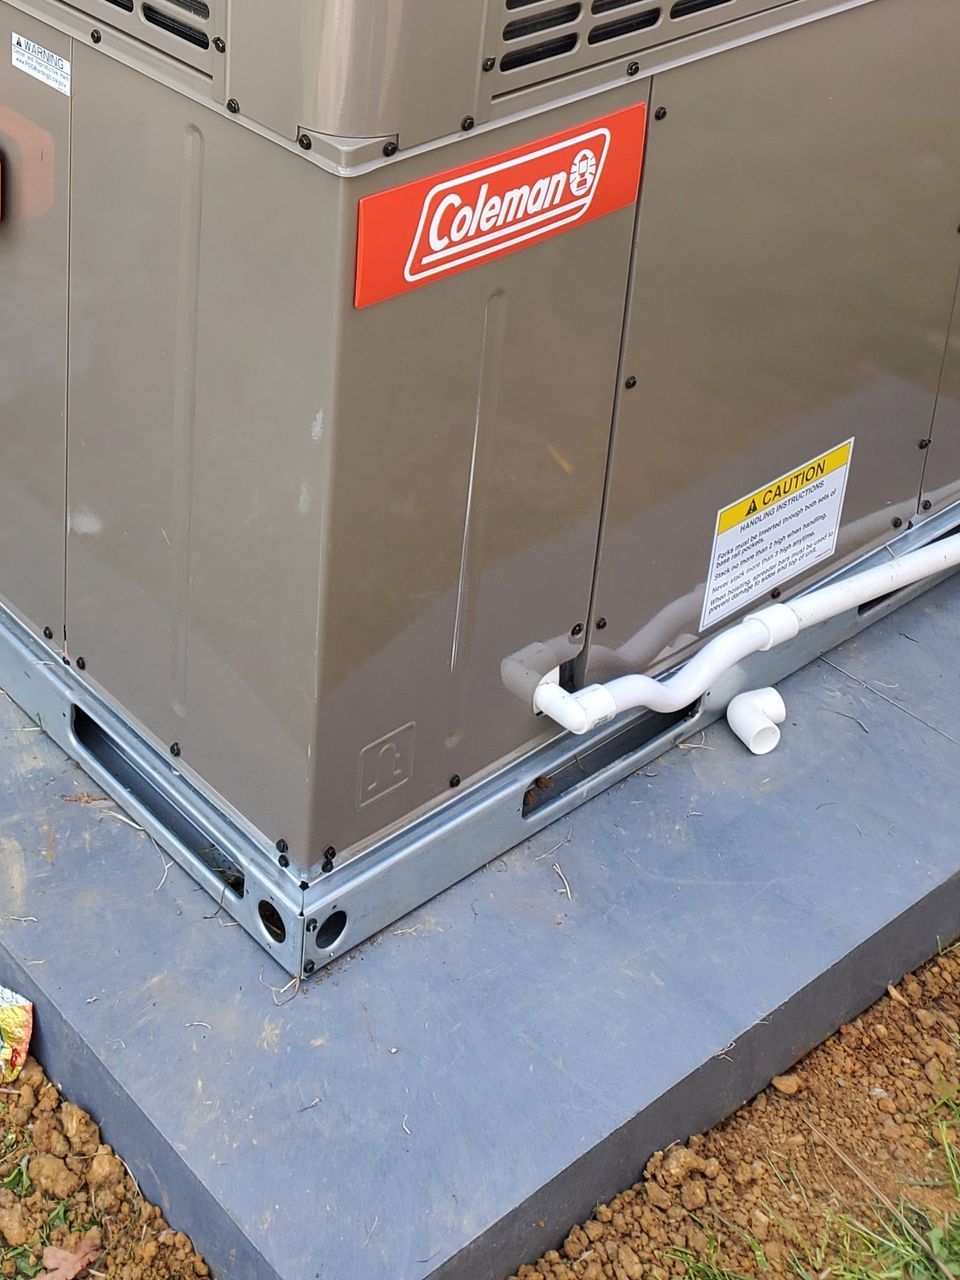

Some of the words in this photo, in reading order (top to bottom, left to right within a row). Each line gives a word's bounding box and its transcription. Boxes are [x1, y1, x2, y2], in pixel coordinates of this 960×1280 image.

[24, 39, 64, 70] WARNING
[428, 170, 567, 252] Coleman
[739, 507, 775, 533] HANDLING
[775, 480, 824, 512] INSTRUCTIONS
[762, 459, 826, 506] CAUTION
[717, 547, 734, 561] Forks
[734, 537, 749, 551] must
[758, 519, 781, 537] inserted
[782, 507, 803, 524] through
[804, 500, 817, 511] both
[817, 493, 829, 504] sets
